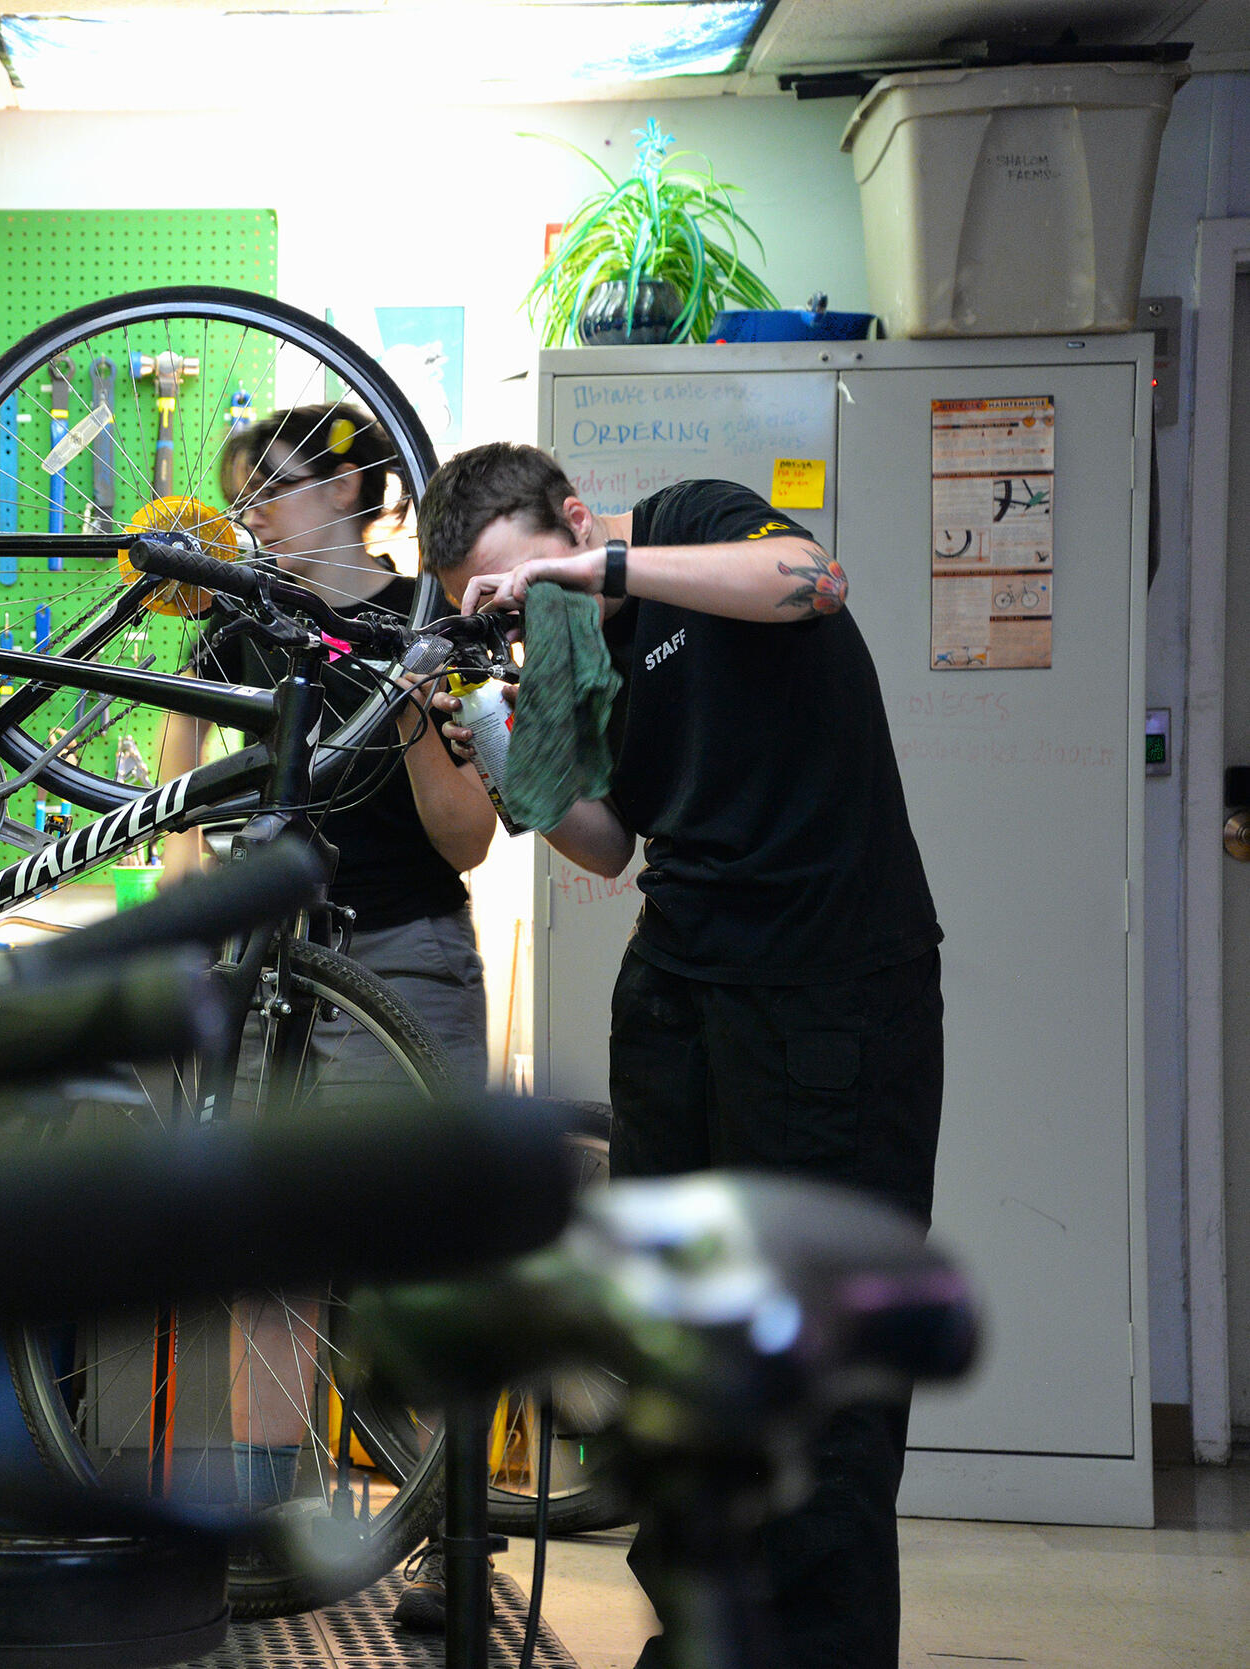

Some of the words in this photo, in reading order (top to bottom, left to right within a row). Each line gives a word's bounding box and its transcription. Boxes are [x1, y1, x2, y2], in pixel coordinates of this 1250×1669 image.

[996, 154, 1049, 167] SHALOM
[988, 400, 1045, 410] MAINTENANCE
[573, 418, 710, 447] ORDERING
[644, 627, 687, 671] STAFF
